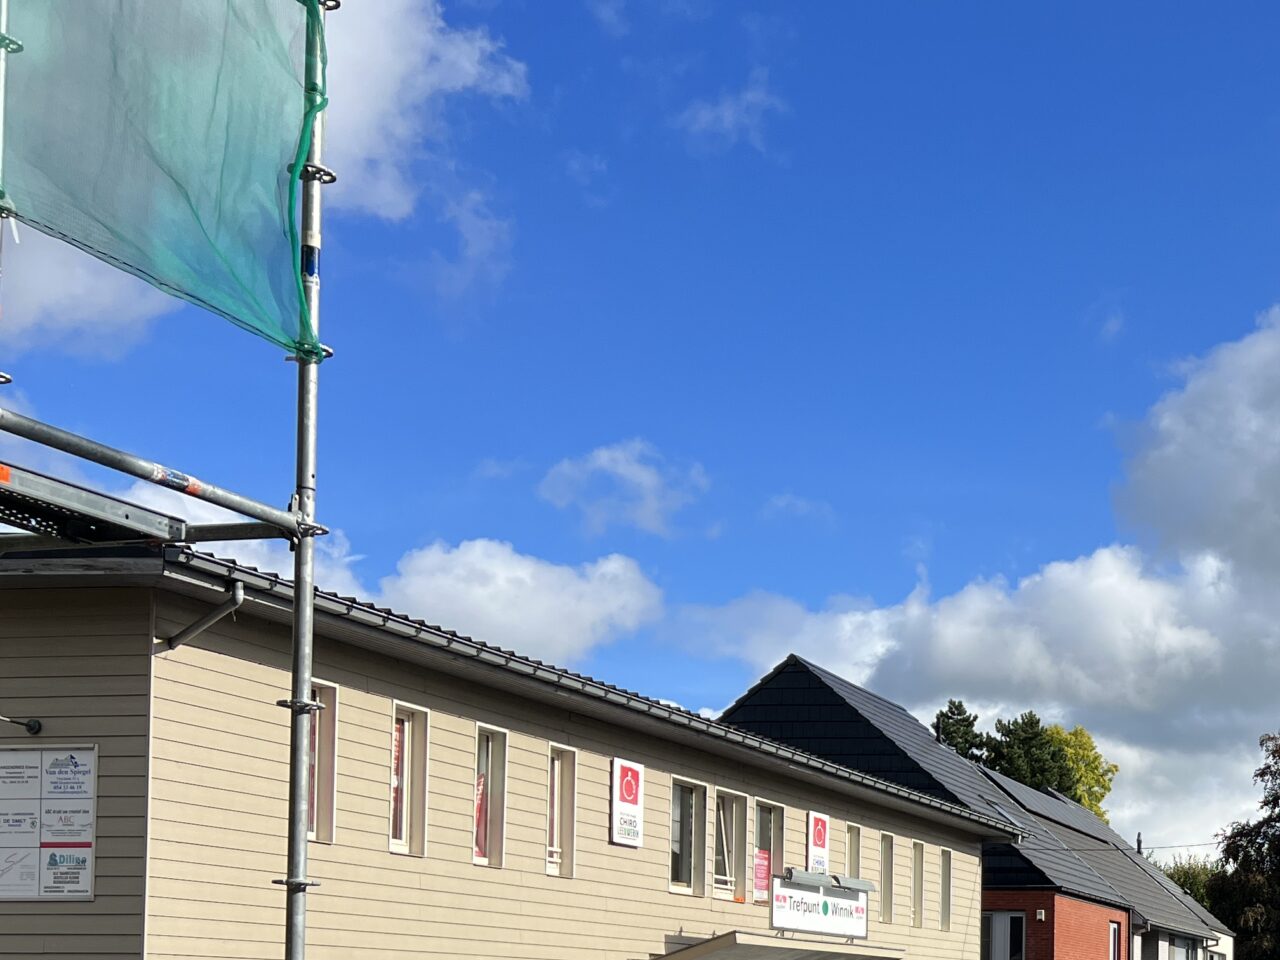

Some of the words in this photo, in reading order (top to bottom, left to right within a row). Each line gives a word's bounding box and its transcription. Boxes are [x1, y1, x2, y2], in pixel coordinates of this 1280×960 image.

[619, 817, 637, 828] CHIRO
[788, 895, 820, 915] Trefpunt
[831, 902, 854, 919] Winnik
